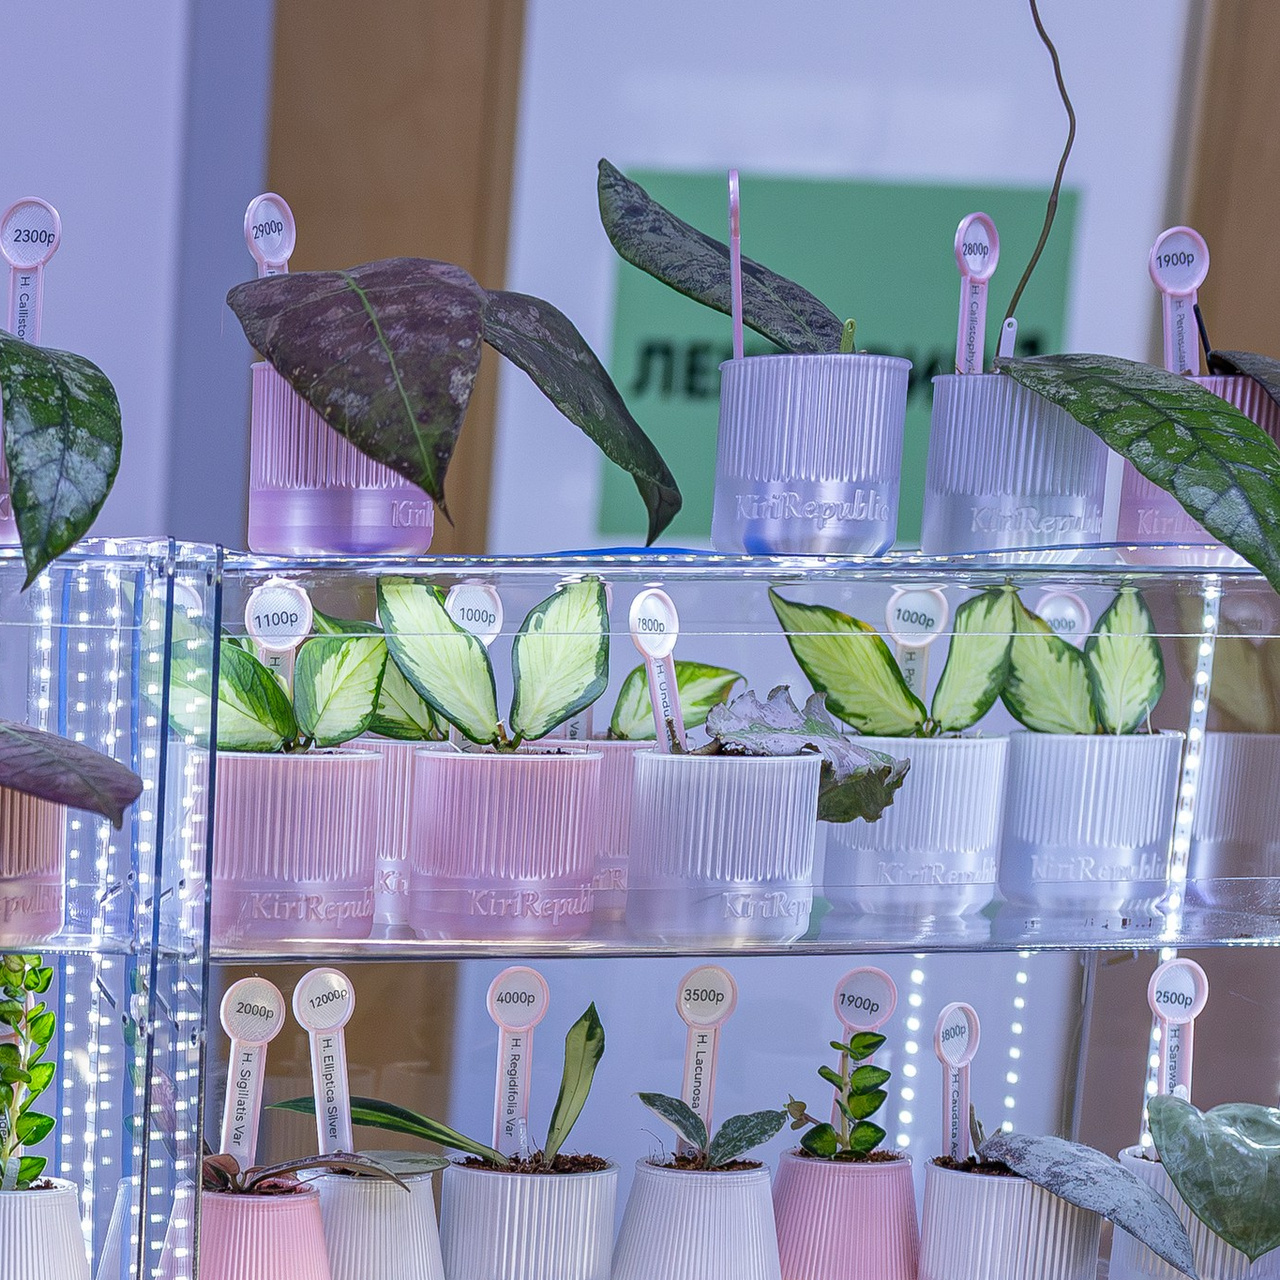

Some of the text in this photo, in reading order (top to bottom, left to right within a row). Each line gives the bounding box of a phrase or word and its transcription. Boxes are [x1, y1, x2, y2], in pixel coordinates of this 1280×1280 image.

[322, 1055, 335, 1103] Elliptica
[692, 1051, 706, 1109] Lacunosa
[233, 1124, 245, 1146] Var
[328, 1106, 338, 1140] Silver
[505, 1118, 516, 1137] Var
